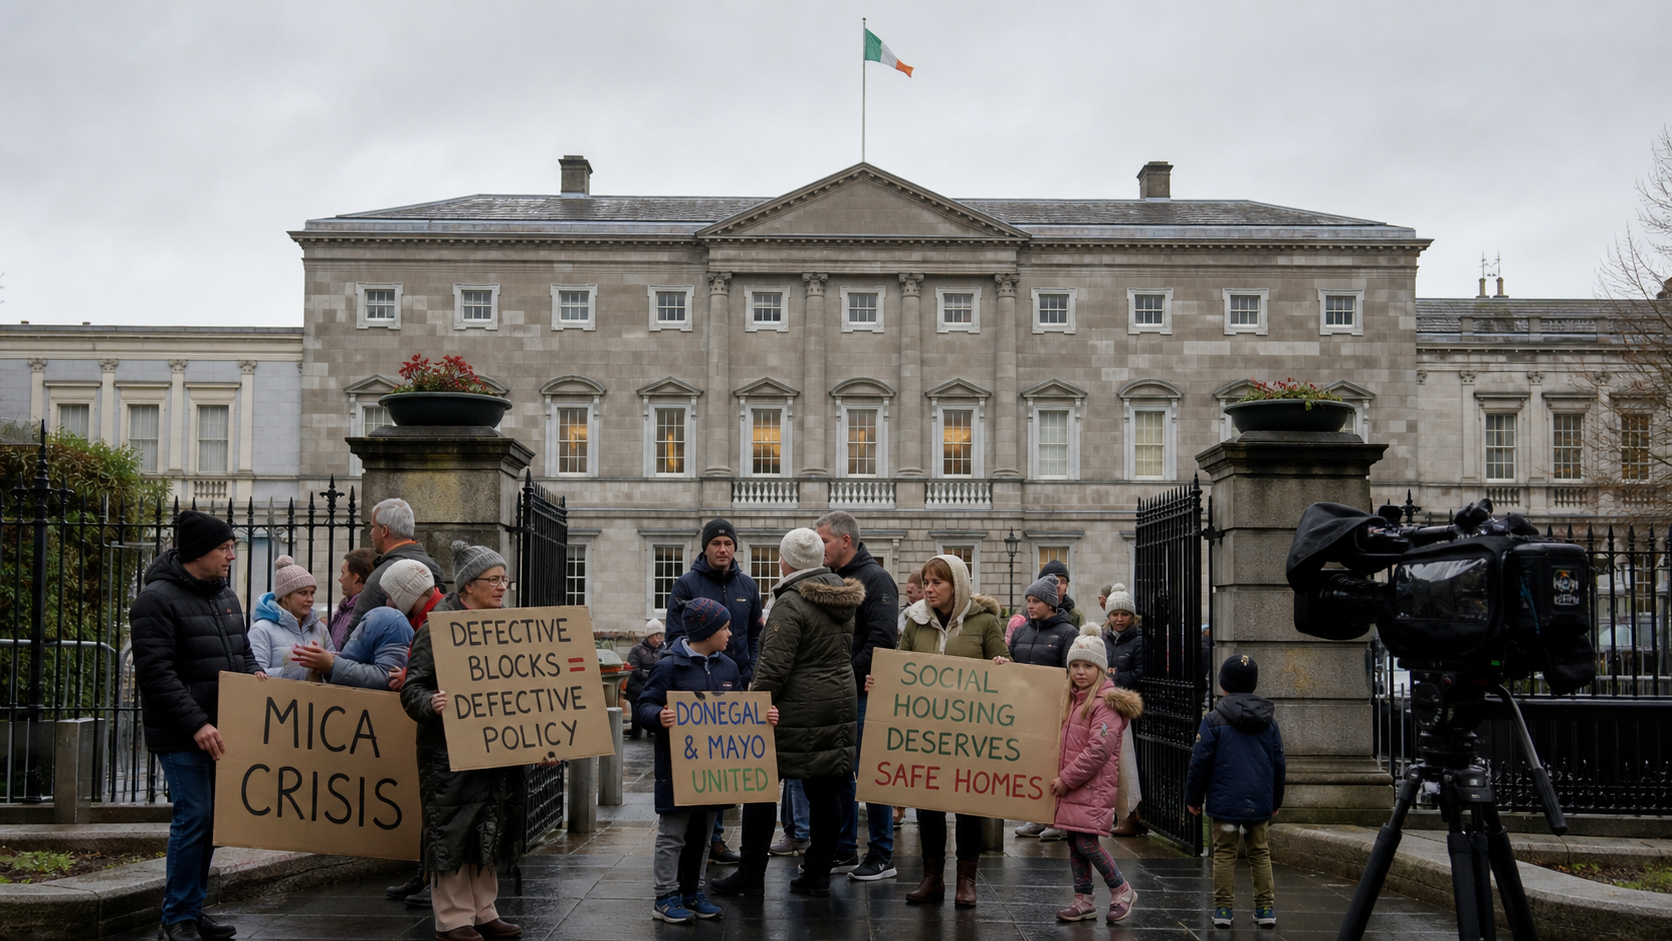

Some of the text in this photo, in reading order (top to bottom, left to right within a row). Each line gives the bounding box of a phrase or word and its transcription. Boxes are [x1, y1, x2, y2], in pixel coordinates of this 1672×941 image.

[450, 618, 572, 647] DEFECTIVE
[468, 652, 561, 682] BLOCKS
[900, 661, 999, 694] SOCIAL
[454, 686, 587, 720] DEFECTIVE
[676, 700, 767, 727] DONEGAL
[893, 694, 1016, 728] HOUSING
[263, 696, 380, 758] MICA
[482, 719, 578, 753] POLICY
[886, 726, 1021, 762] DESERVES
[684, 734, 766, 760] & MAYO
[240, 763, 403, 830] CRISIS
[691, 767, 769, 794] UNITED
[874, 761, 1044, 801] SAFE HOMES
